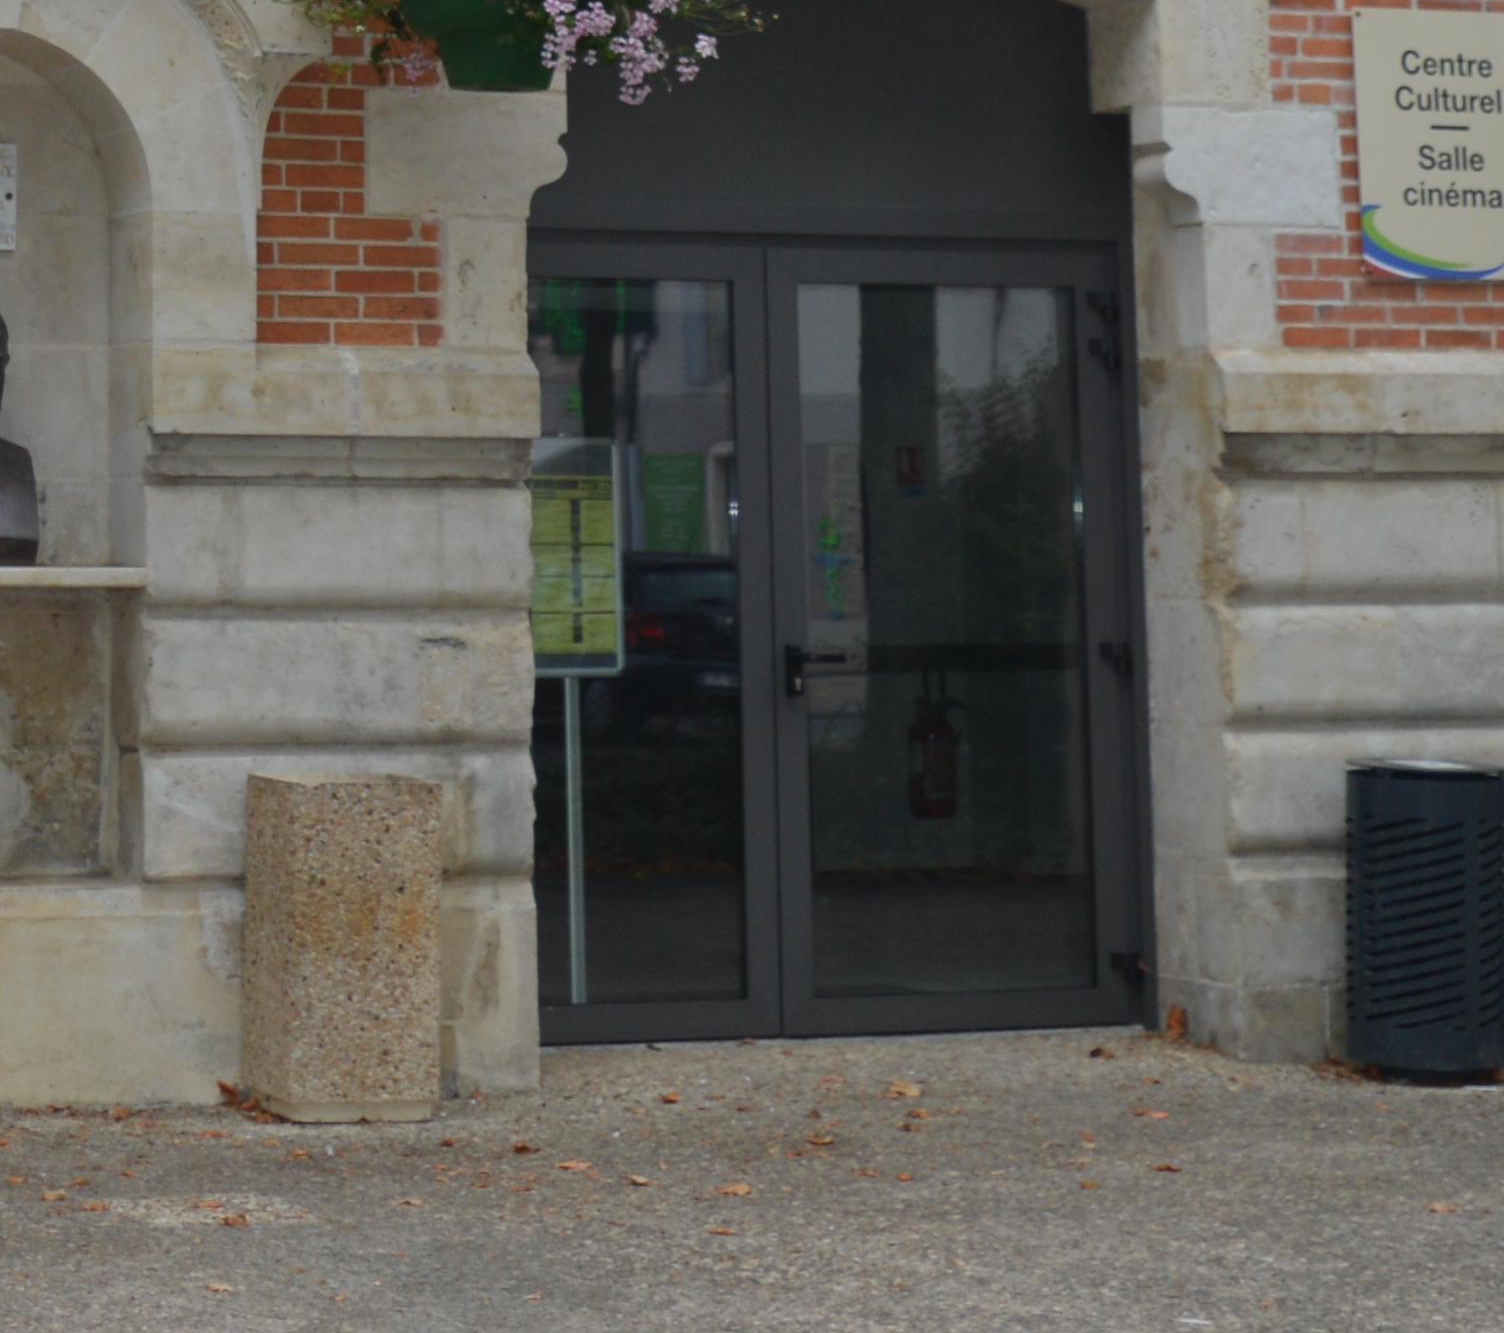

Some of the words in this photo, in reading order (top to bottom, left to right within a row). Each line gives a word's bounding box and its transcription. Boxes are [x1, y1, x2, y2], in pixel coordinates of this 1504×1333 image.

[1401, 50, 1493, 78] Centre
[1395, 86, 1503, 114] Culturel
[1418, 145, 1485, 171] Salle
[1403, 182, 1504, 208] cinéma
